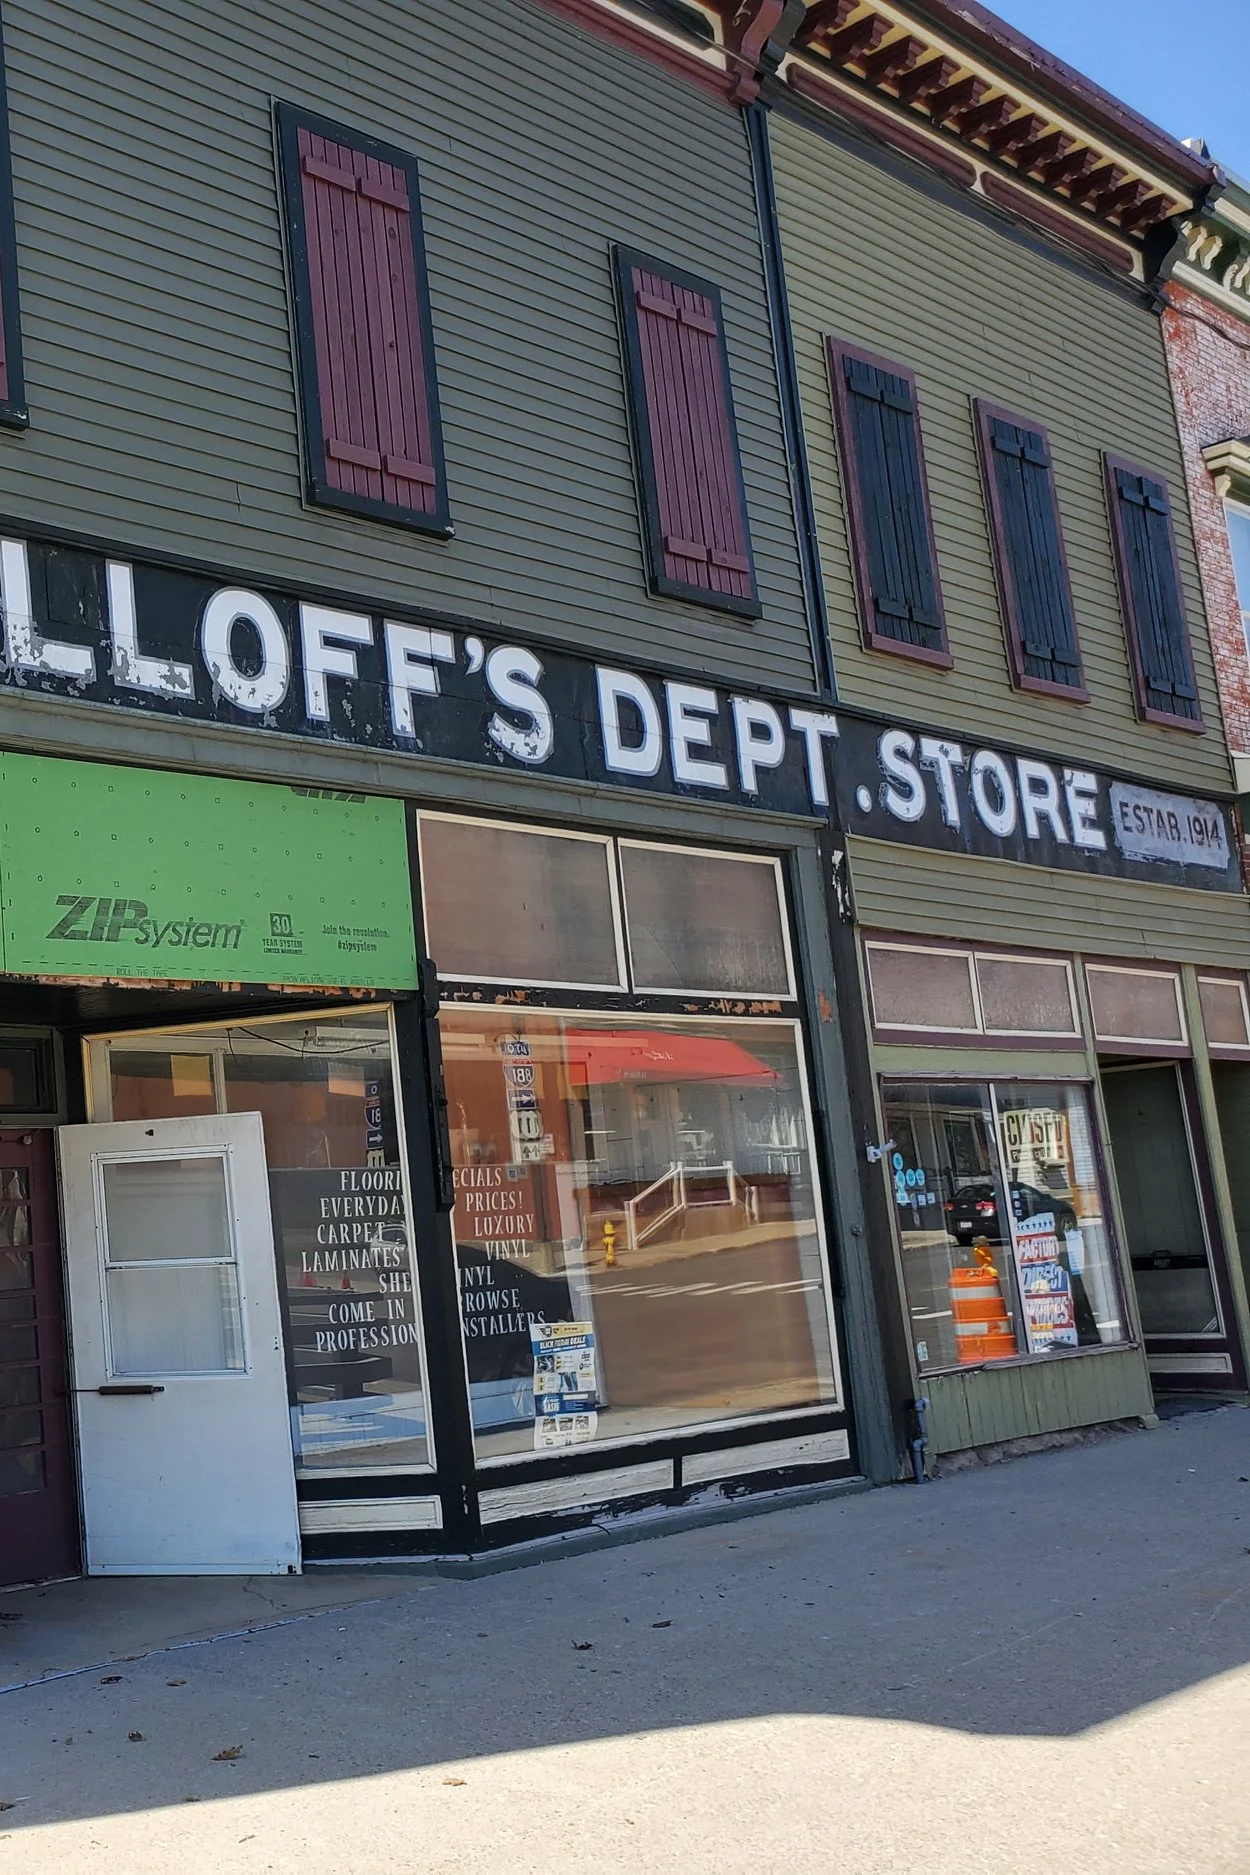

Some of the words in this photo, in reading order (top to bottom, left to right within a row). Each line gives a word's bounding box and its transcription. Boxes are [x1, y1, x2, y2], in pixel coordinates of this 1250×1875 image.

[877, 728, 1107, 851] STORE
[271, 915, 291, 935] 30
[322, 924, 338, 935] Join
[339, 926, 351, 936] the
[262, 938, 278, 947] YEAR
[280, 939, 303, 948] SYSTEM
[137, 968, 150, 977] THE
[465, 1190, 523, 1212] PRICES!
[316, 1221, 386, 1244] CARPET
[474, 1213, 535, 1237] LUXURY
[301, 1246, 401, 1273] LAMINATES
[485, 1238, 530, 1261] VINYL
[328, 1301, 375, 1325] COME
[388, 1298, 405, 1320] IN
[462, 1289, 520, 1313] ROWSE
